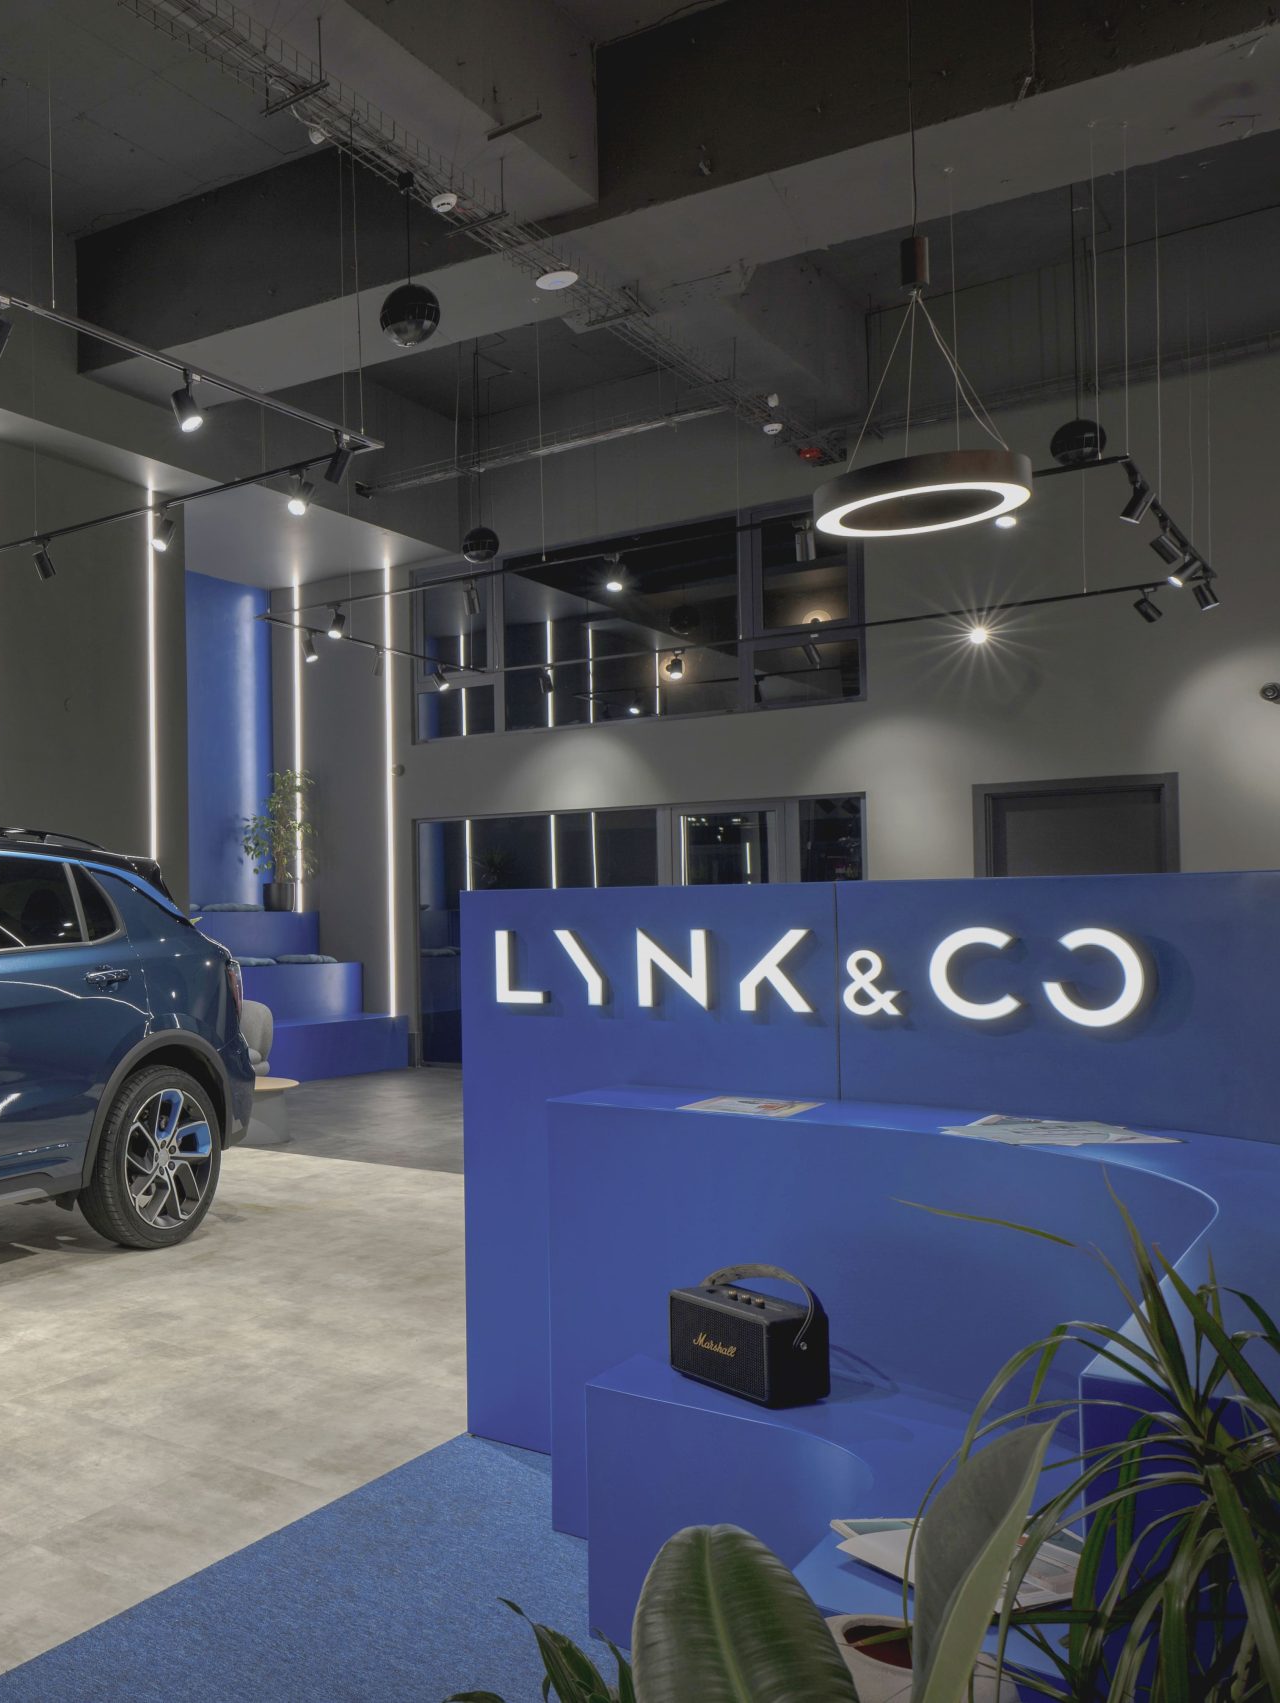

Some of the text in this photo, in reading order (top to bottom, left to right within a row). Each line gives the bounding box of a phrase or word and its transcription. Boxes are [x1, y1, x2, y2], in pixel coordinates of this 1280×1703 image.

[493, 928, 813, 1014] LYNK
[841, 948, 903, 1017] &
[693, 1332, 737, 1358] Marshall
